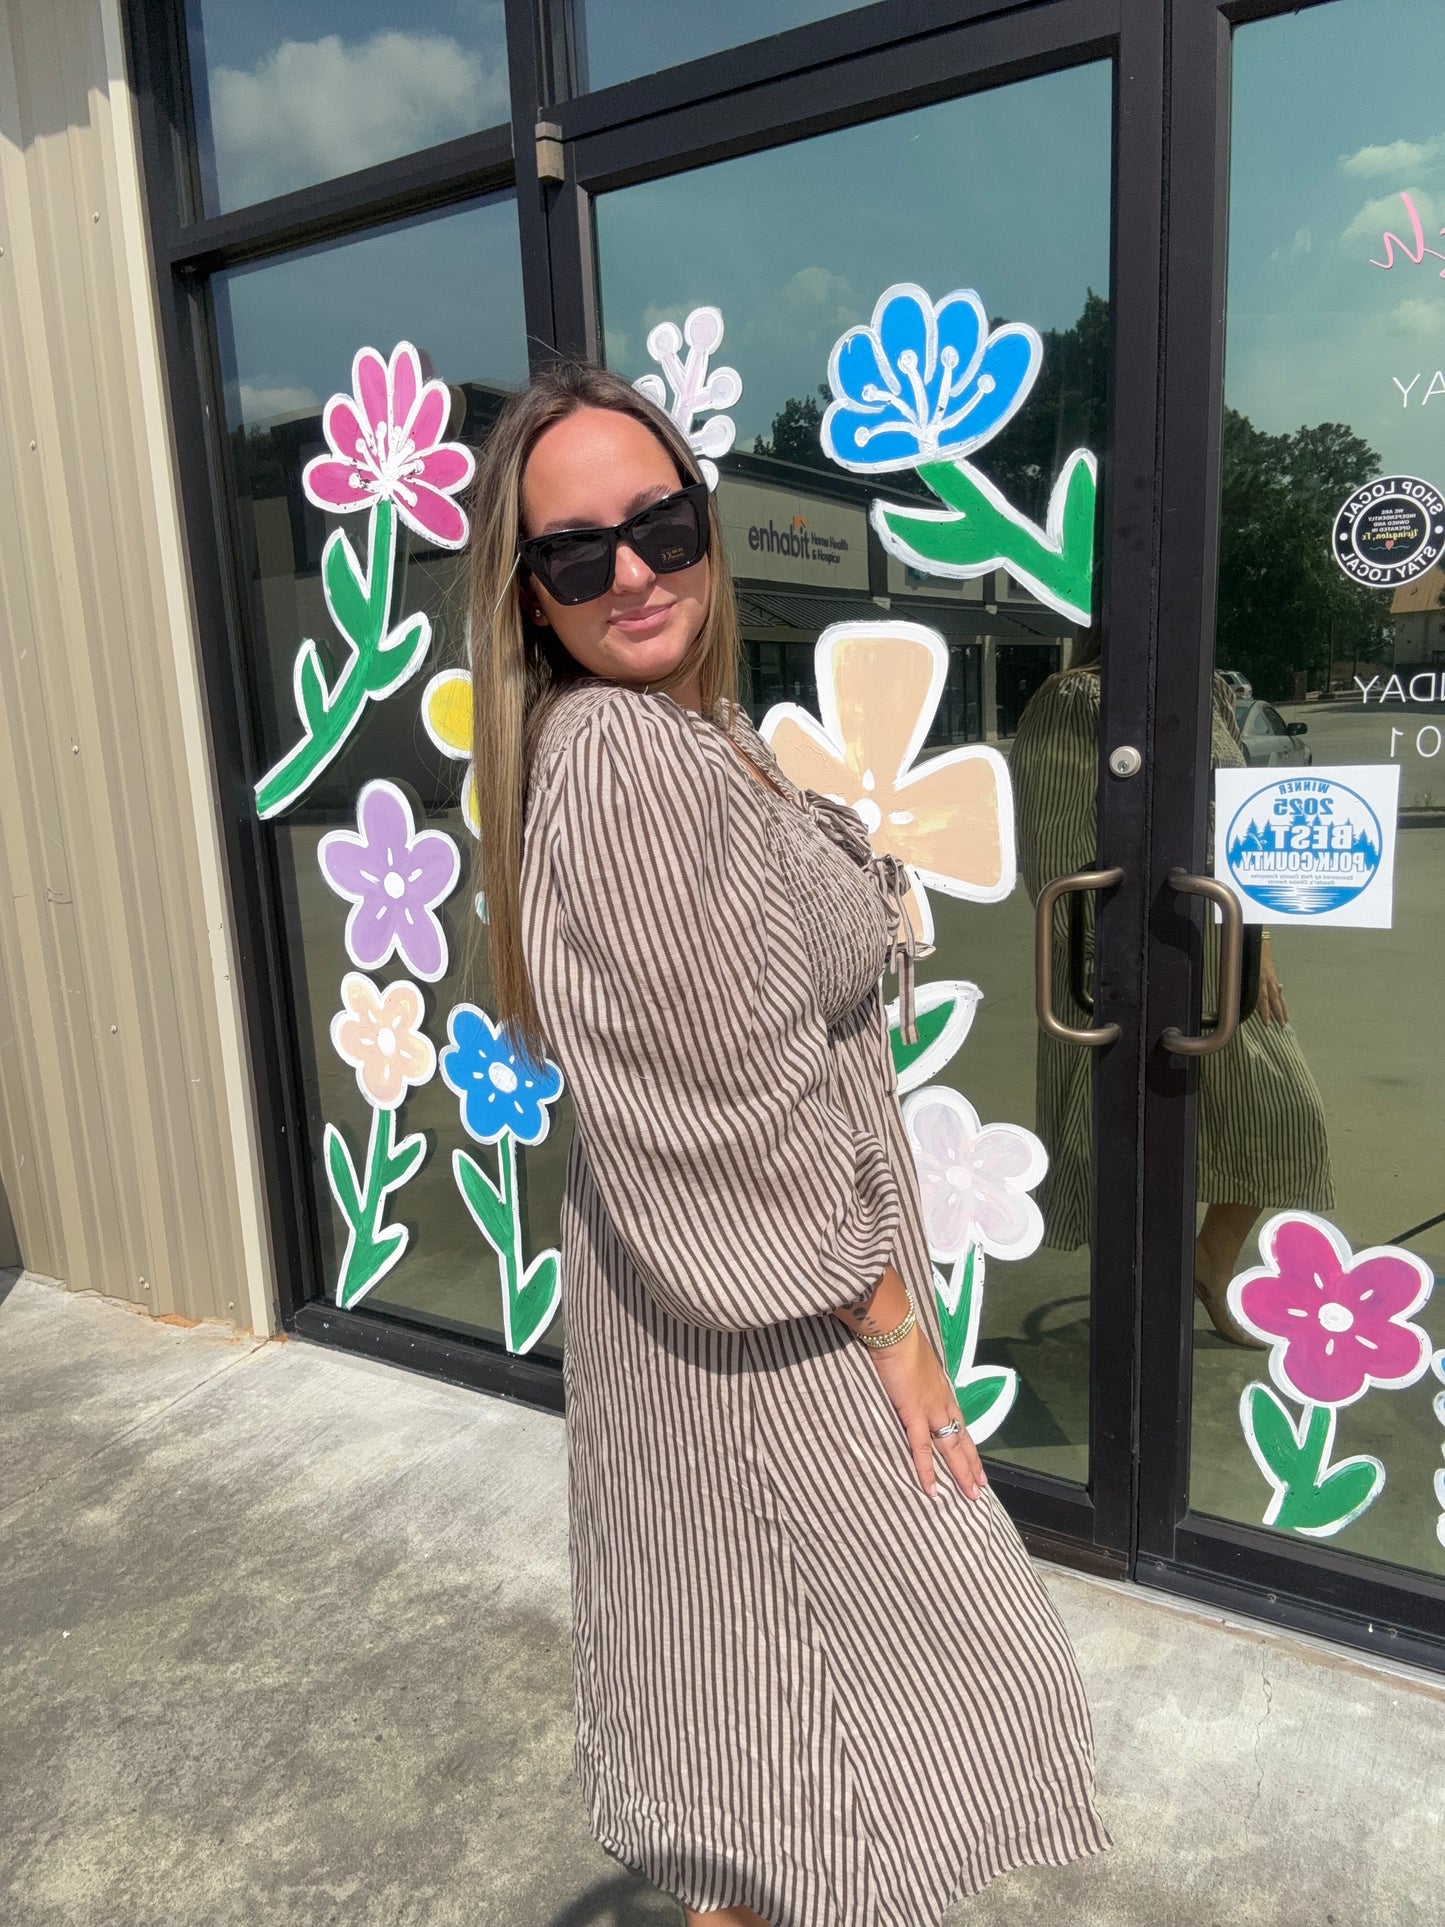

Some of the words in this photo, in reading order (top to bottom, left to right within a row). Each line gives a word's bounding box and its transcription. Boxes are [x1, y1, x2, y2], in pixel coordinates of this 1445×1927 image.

[748, 520, 810, 560] enhabit
[811, 531, 828, 547] Home
[829, 536, 848, 550] Health
[817, 550, 841, 564] Hospice
